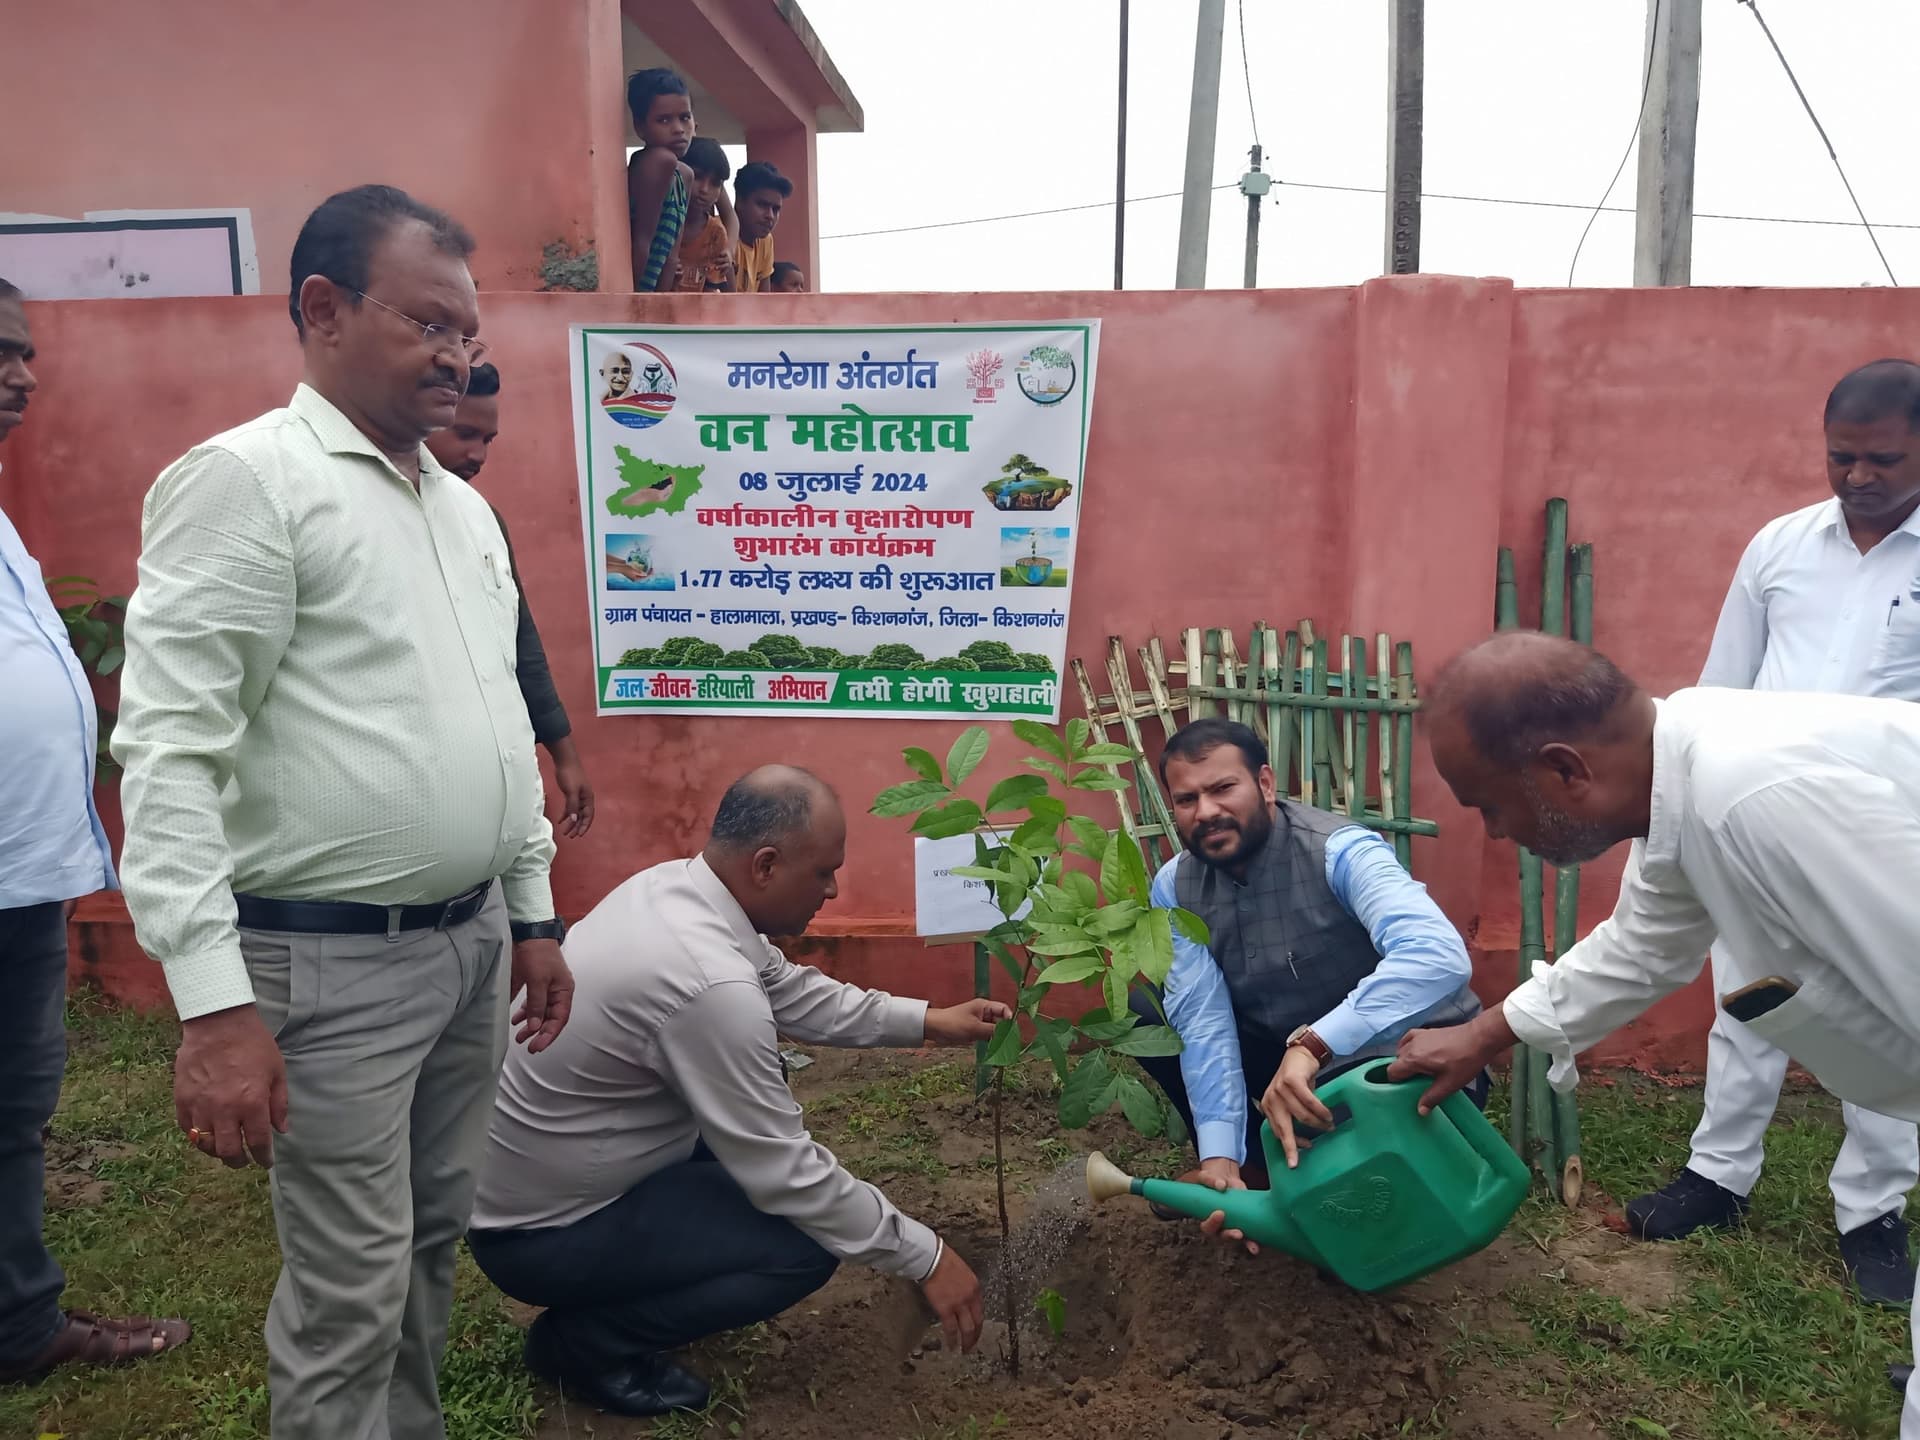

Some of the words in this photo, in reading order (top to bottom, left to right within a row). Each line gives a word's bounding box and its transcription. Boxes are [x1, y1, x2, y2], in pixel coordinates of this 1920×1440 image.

[728, 351, 829, 389] मनरेगा
[837, 349, 938, 389] अंतर्गत
[695, 415, 770, 451] वन
[786, 403, 973, 452] महोत्सव
[739, 472, 767, 491] 08
[775, 464, 864, 502] जुलाई
[872, 473, 928, 491] 2024
[696, 502, 838, 528] वर्षाकालीन
[845, 505, 974, 535] वृक्षारोपण
[734, 533, 823, 562] शुभारंभ
[829, 531, 936, 558] कार्यक्रम
[680, 570, 722, 587] 1.77
[729, 563, 792, 595] करोड़
[798, 571, 853, 590] लक्ष्य
[859, 564, 893, 590] की
[900, 572, 995, 601] शुरूआत
[605, 608, 638, 624] ग्राम
[641, 603, 692, 623] पंचायत
[710, 609, 785, 625] हालामाला,
[852, 606, 933, 627] किशनगंज,
[939, 606, 988, 627] जिला-
[614, 672, 755, 700] जल-जीवन-हरियाली
[768, 675, 828, 701] अभियान
[847, 677, 892, 700] तभी
[901, 677, 952, 701] होगी
[961, 680, 1056, 711] खुशहाली
